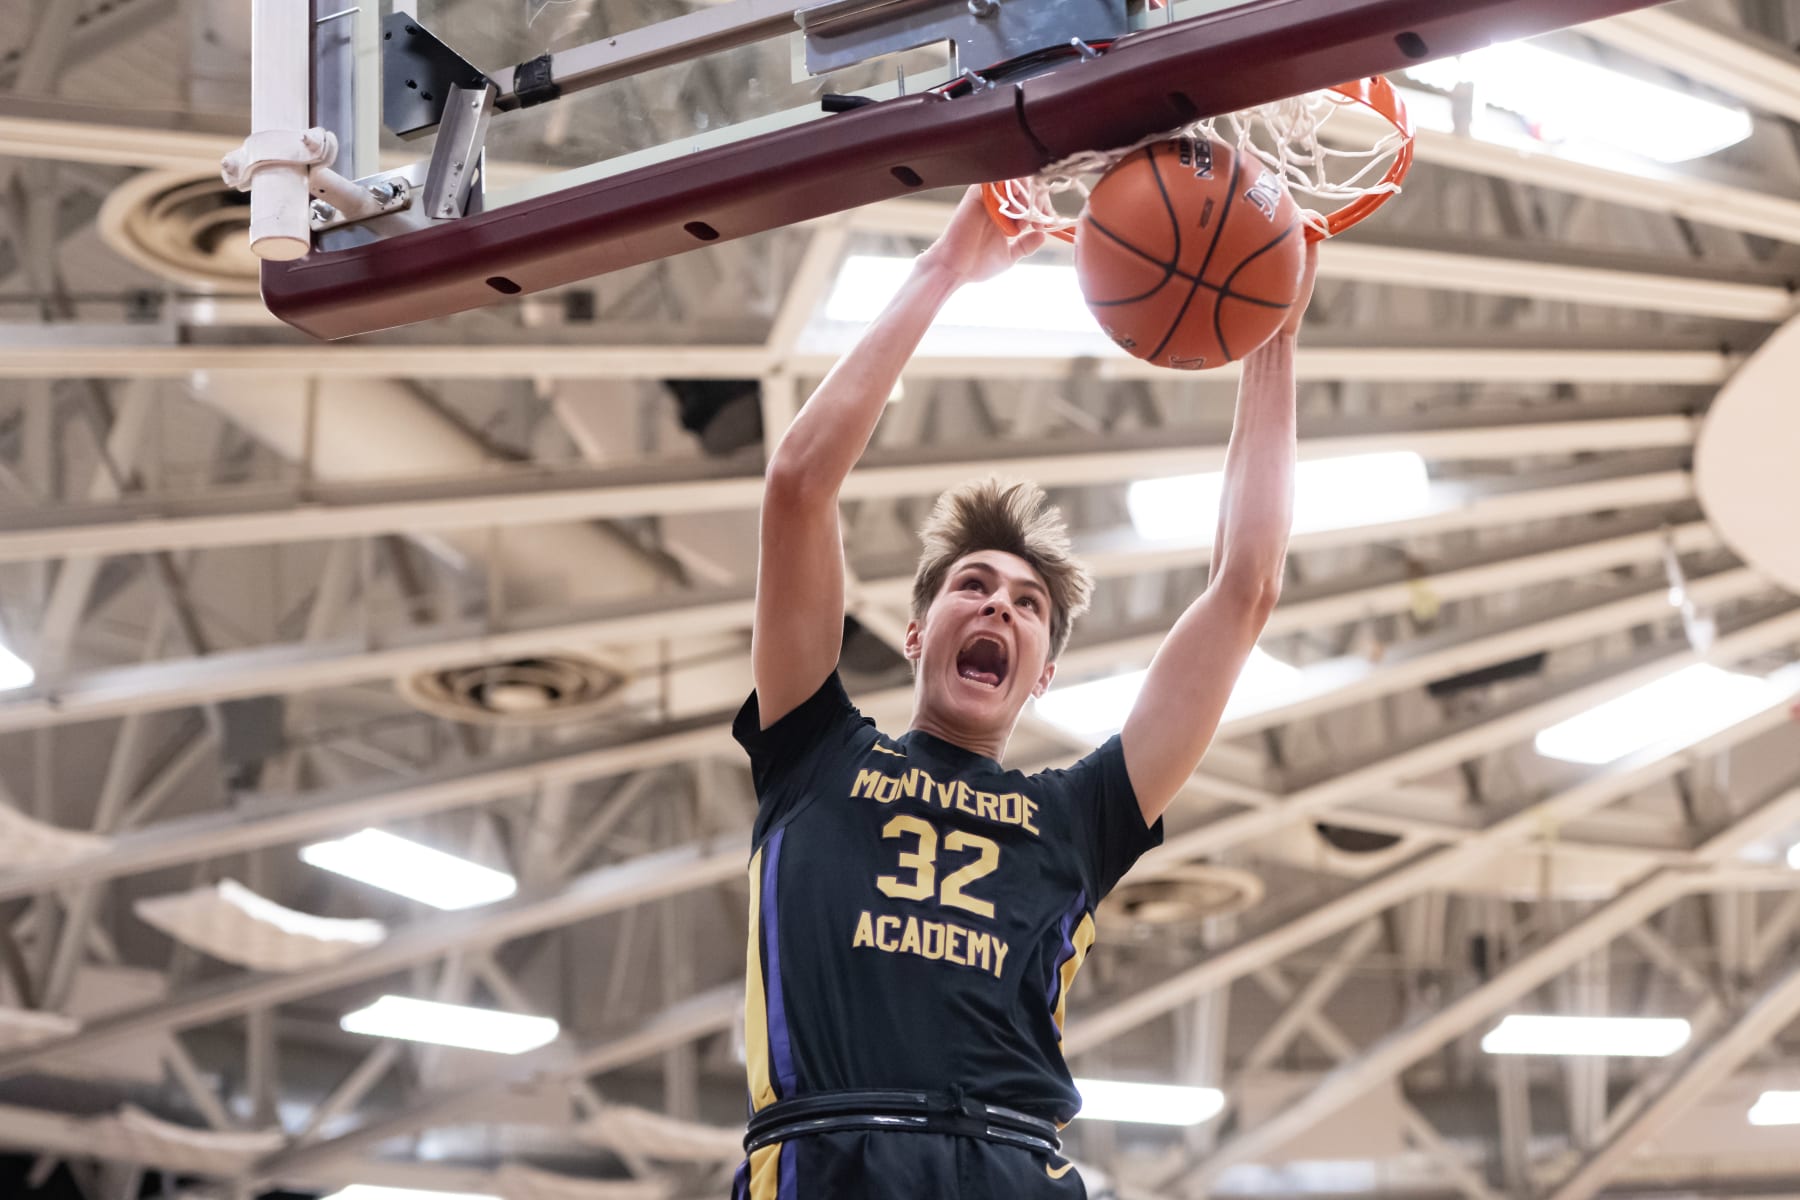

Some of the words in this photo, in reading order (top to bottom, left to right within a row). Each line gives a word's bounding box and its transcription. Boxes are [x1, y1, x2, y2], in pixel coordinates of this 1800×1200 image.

[850, 768, 1040, 836] MONTVERDE
[876, 814, 1000, 919] 32
[852, 910, 1009, 978] ACADEMY
